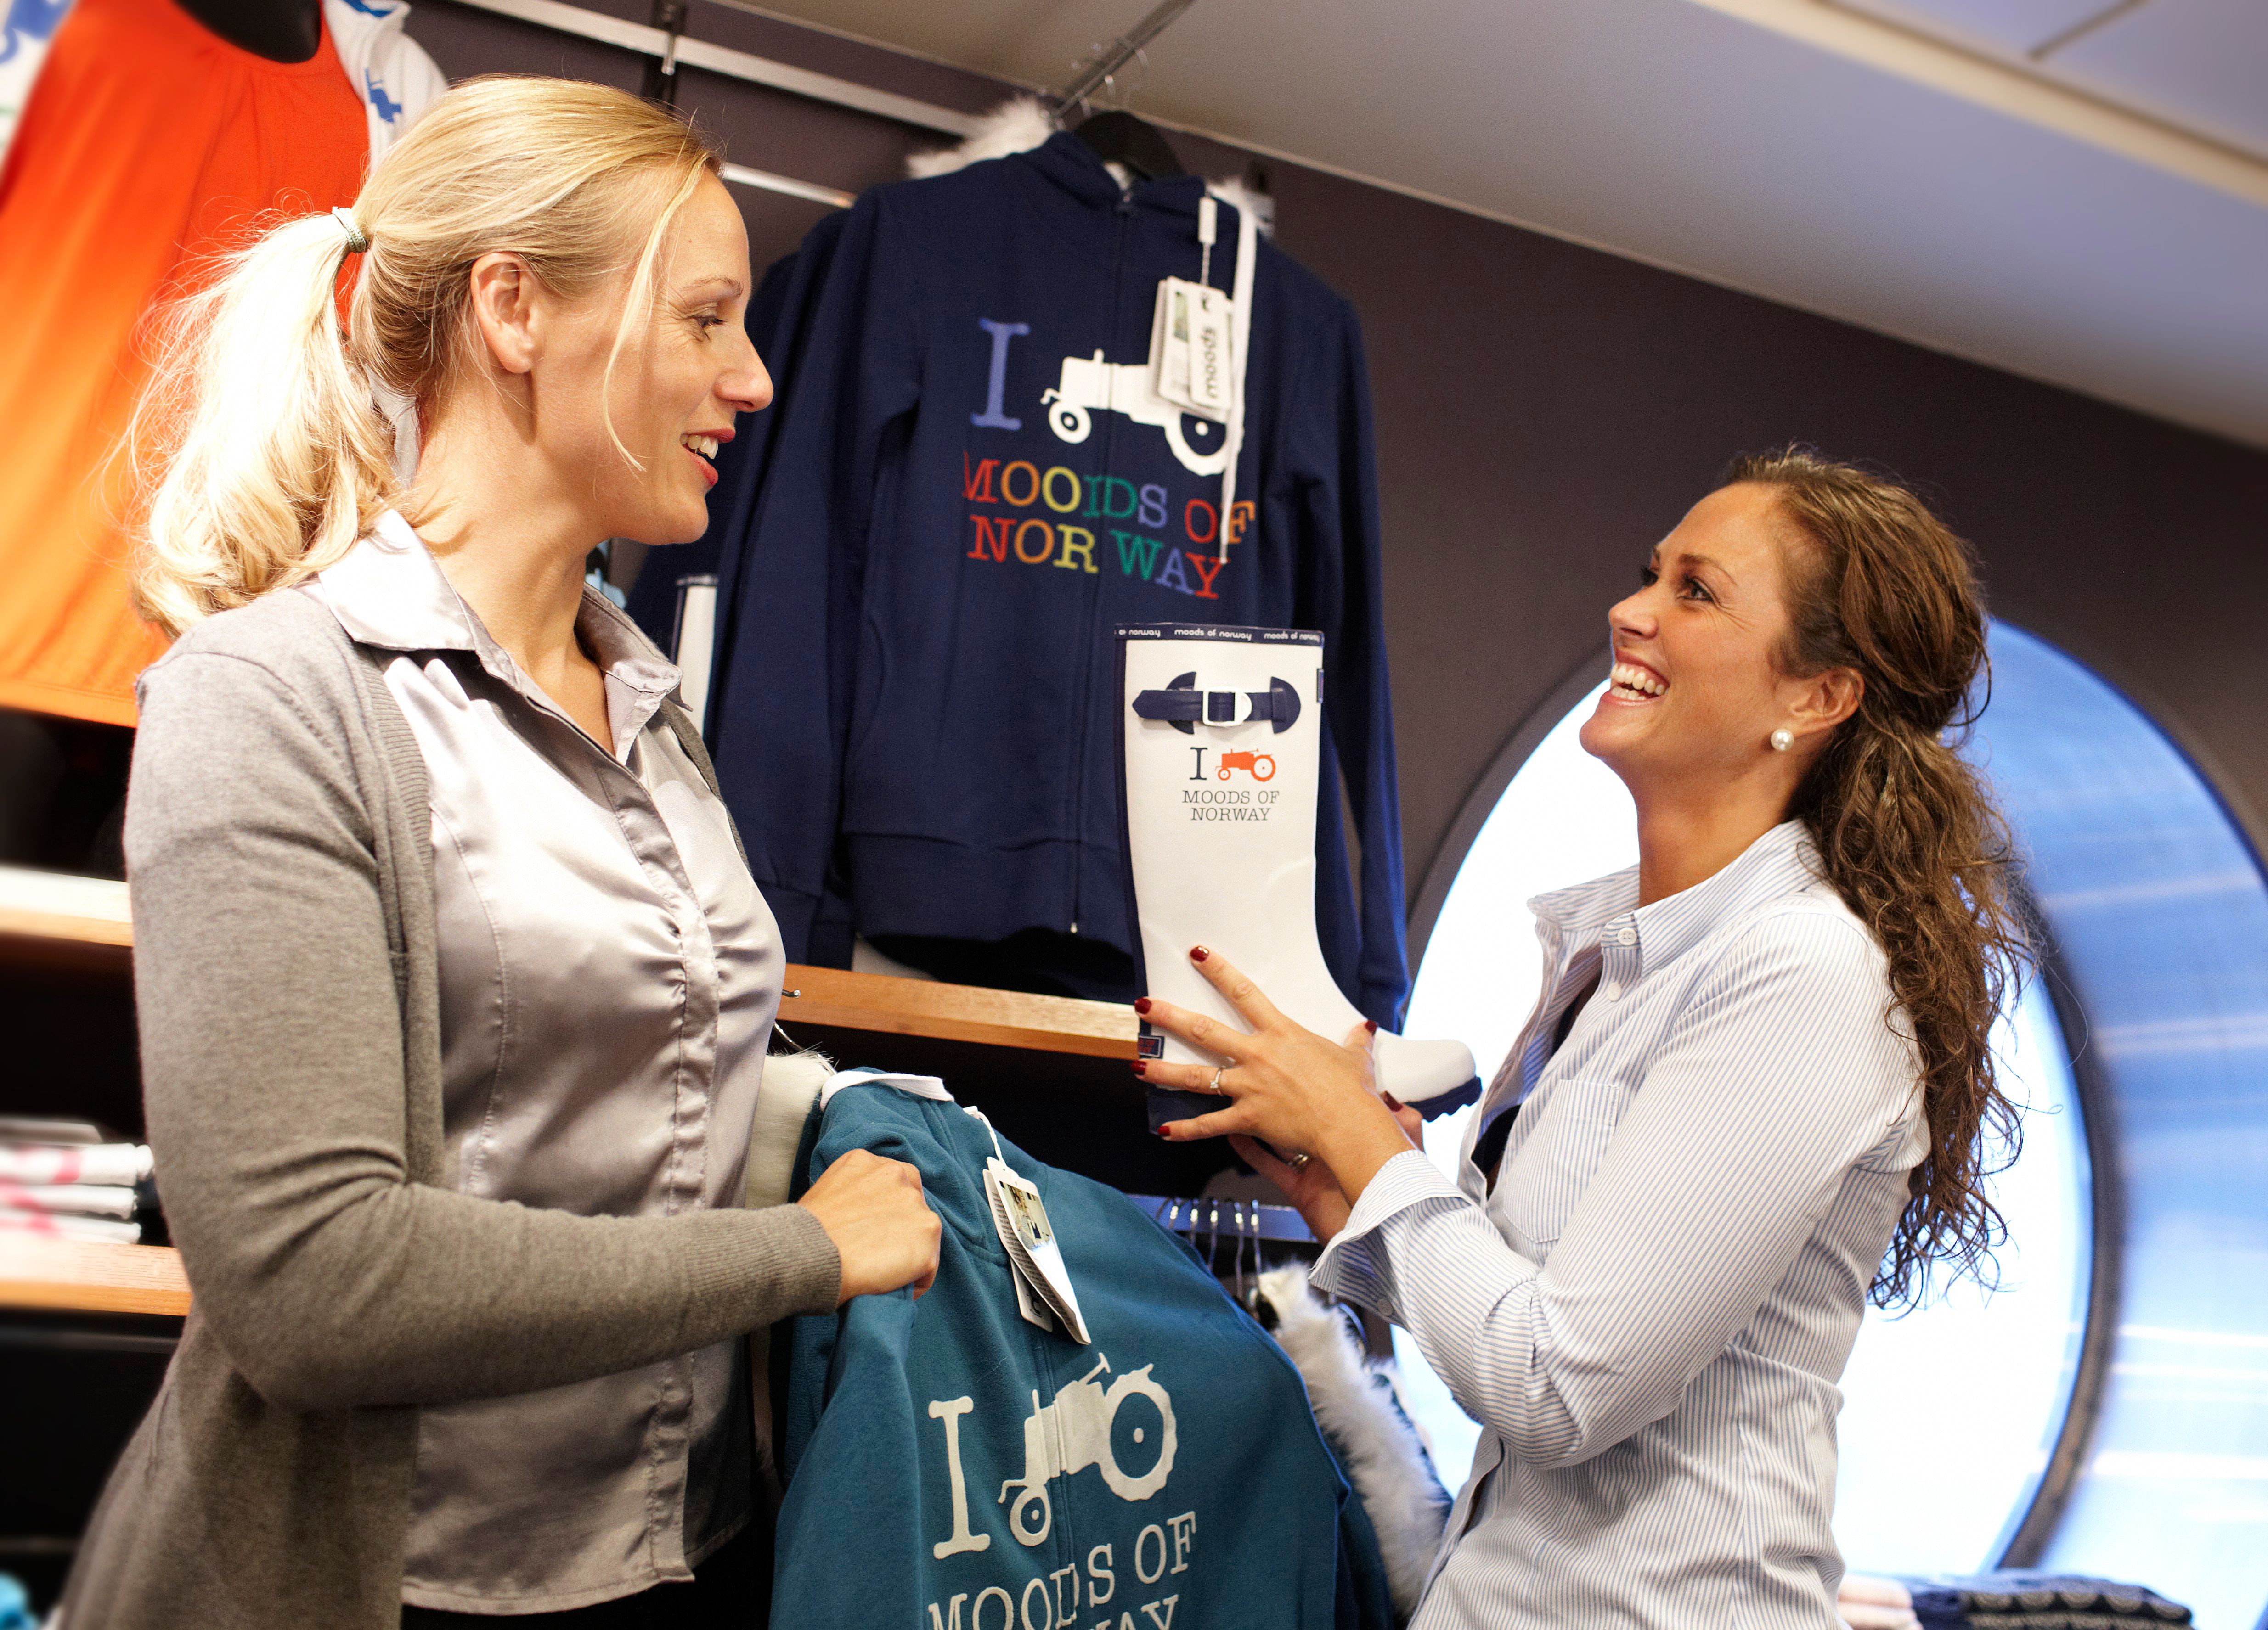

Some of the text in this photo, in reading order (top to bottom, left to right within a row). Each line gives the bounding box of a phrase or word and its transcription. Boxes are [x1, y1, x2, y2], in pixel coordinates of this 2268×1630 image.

[970, 317, 1031, 430] I
[1201, 326, 1217, 399] moods
[1184, 498, 1256, 544] OF
[1128, 629, 1161, 638] norway
[1174, 628, 1252, 641] moods of norway
[1263, 630, 1289, 640] moods
[1189, 747, 1208, 781] I
[1182, 790, 1280, 804] MOODS OF
[1190, 807, 1272, 821] NORWAY
[928, 1395, 991, 1560] I
[1134, 1511, 1196, 1584] OF
